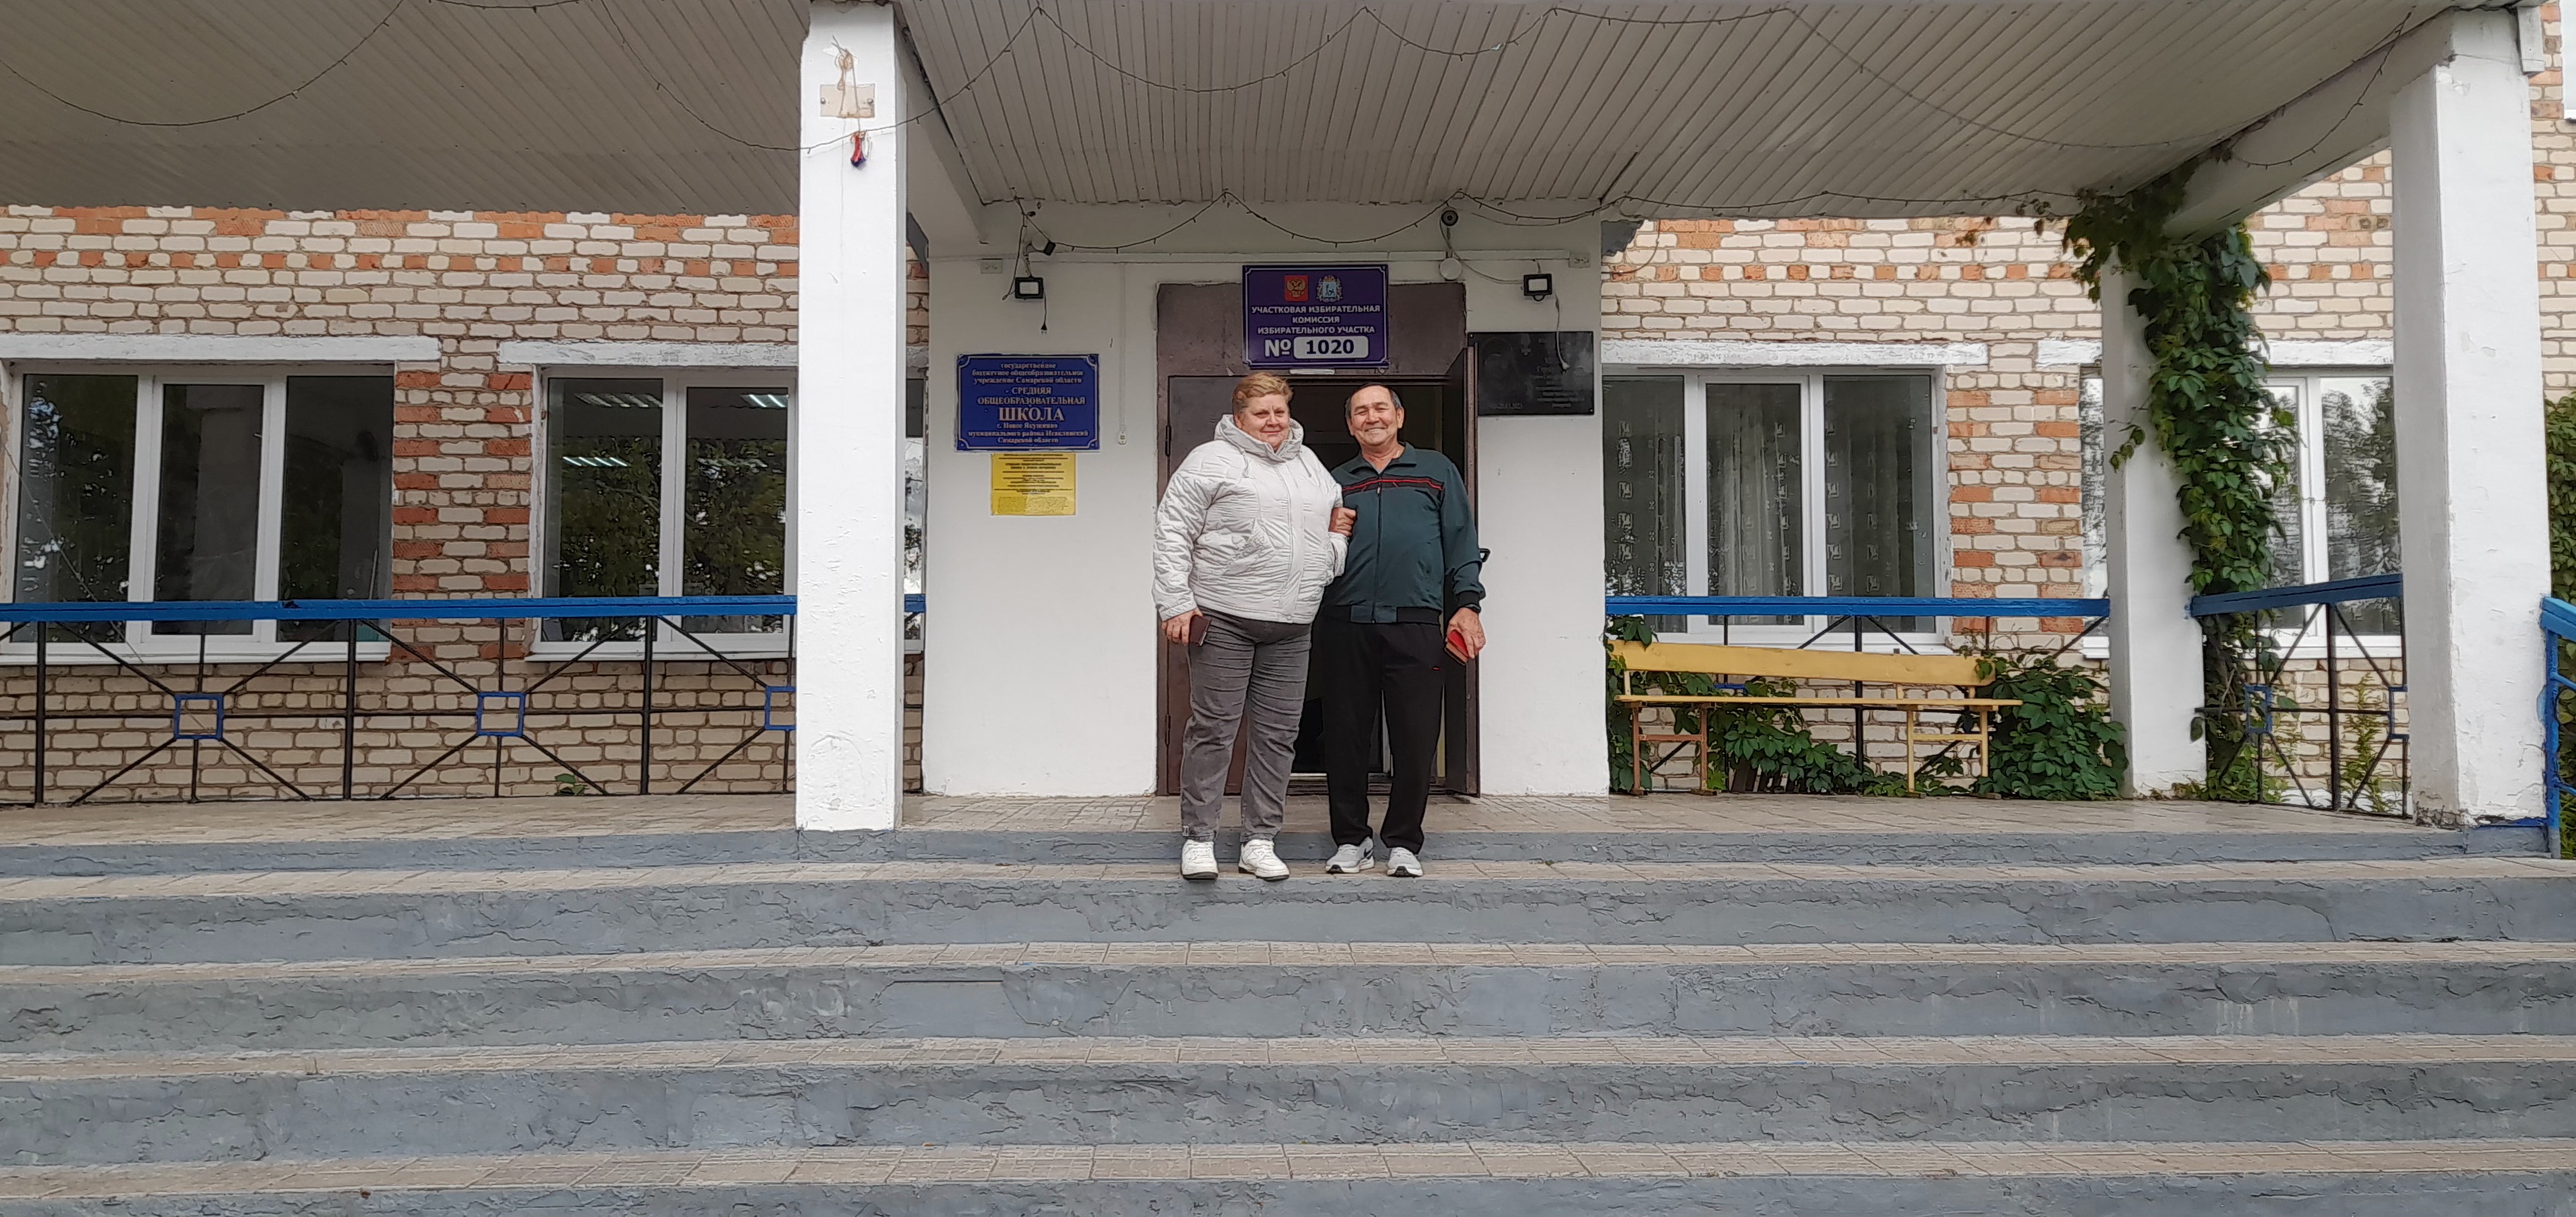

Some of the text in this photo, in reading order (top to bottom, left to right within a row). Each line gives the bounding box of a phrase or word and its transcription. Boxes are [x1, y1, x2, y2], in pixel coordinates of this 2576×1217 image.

[1308, 305, 1380, 313] ИЗБИРАТЕЛЬНАЯ
[1306, 339, 1355, 355] 1020
[998, 407, 1064, 421] ШКОЛА
